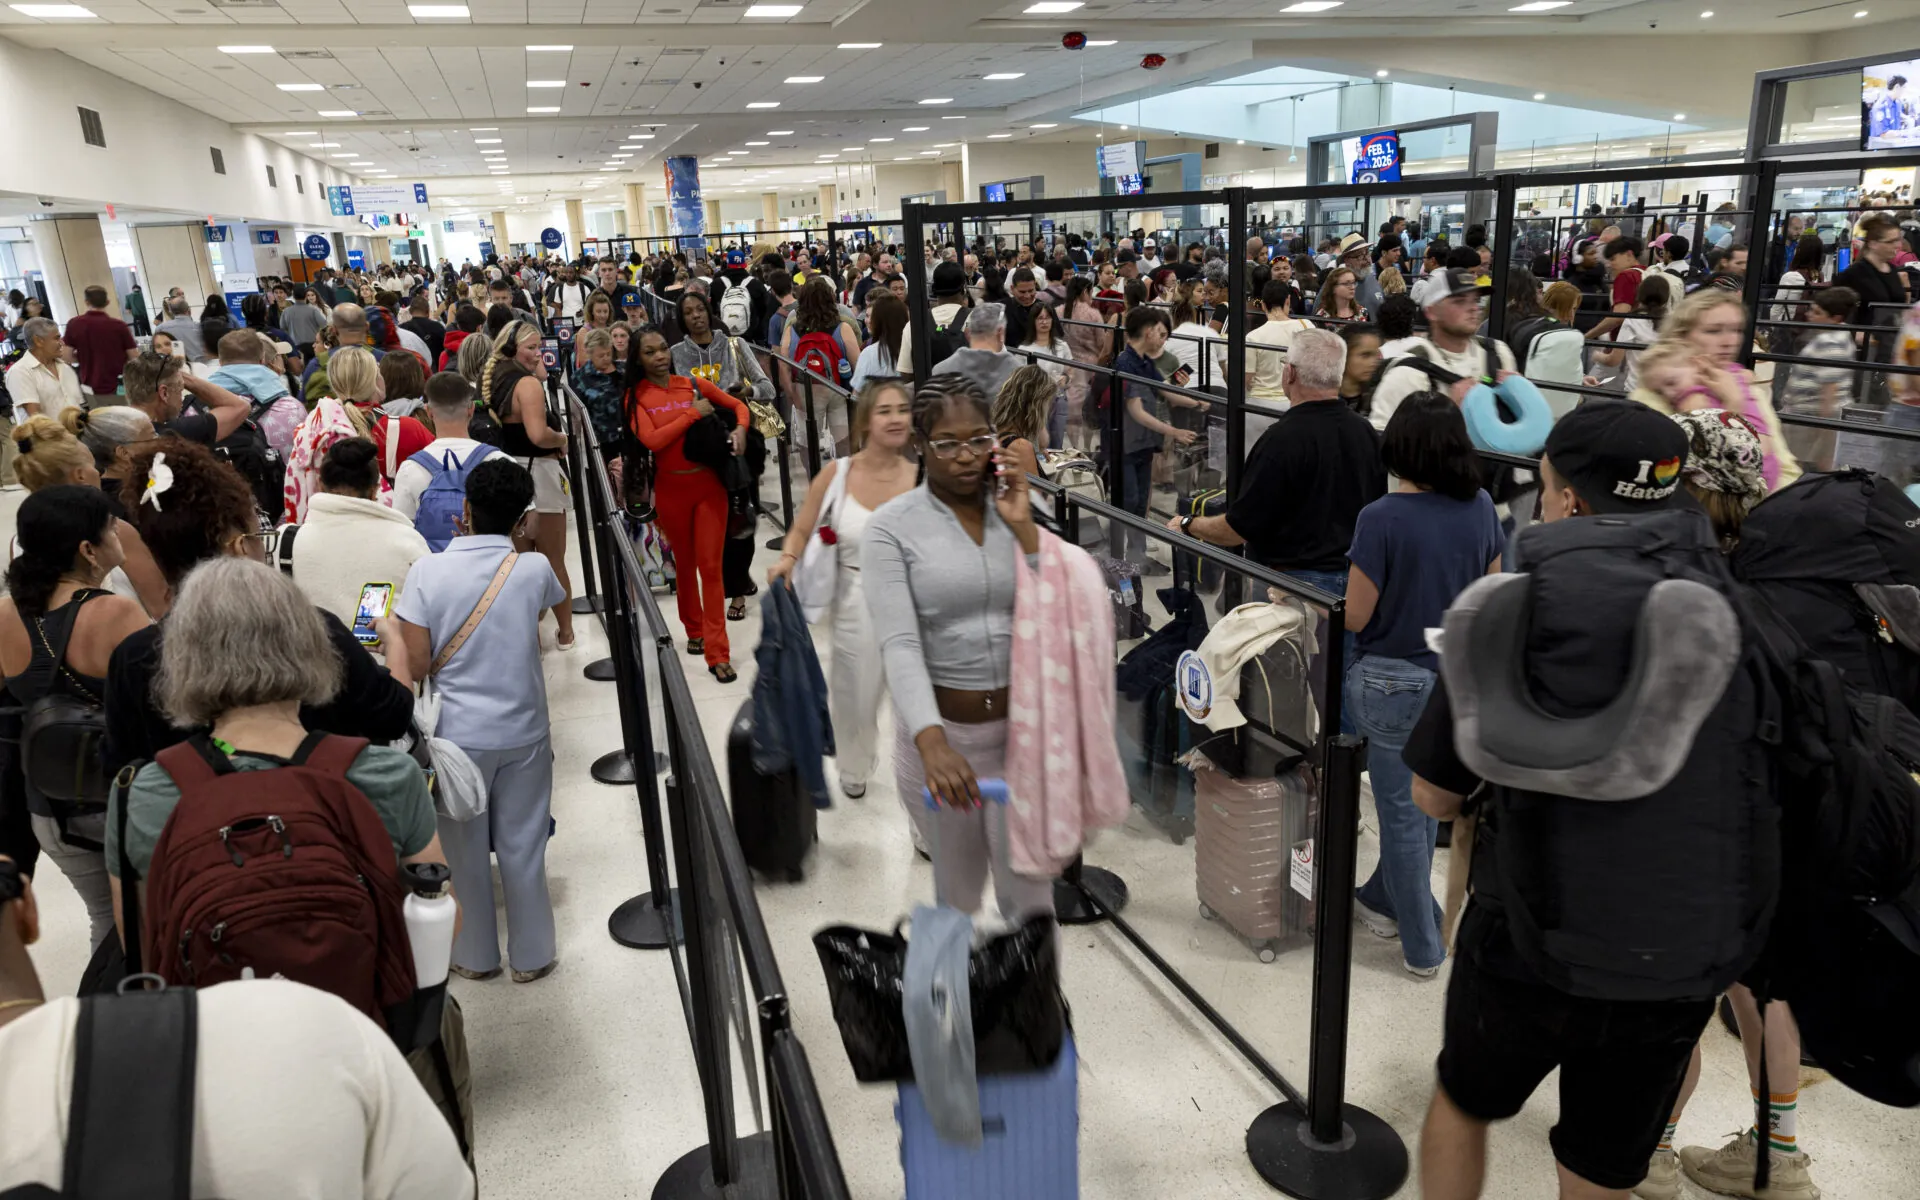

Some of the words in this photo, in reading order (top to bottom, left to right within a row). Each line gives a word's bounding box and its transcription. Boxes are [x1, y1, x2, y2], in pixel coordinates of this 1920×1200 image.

[1367, 143, 1385, 157] FEB.
[1386, 141, 1394, 155] 1,
[1371, 154, 1393, 169] 2026
[626, 295, 635, 303] M
[1633, 460, 1654, 484] I
